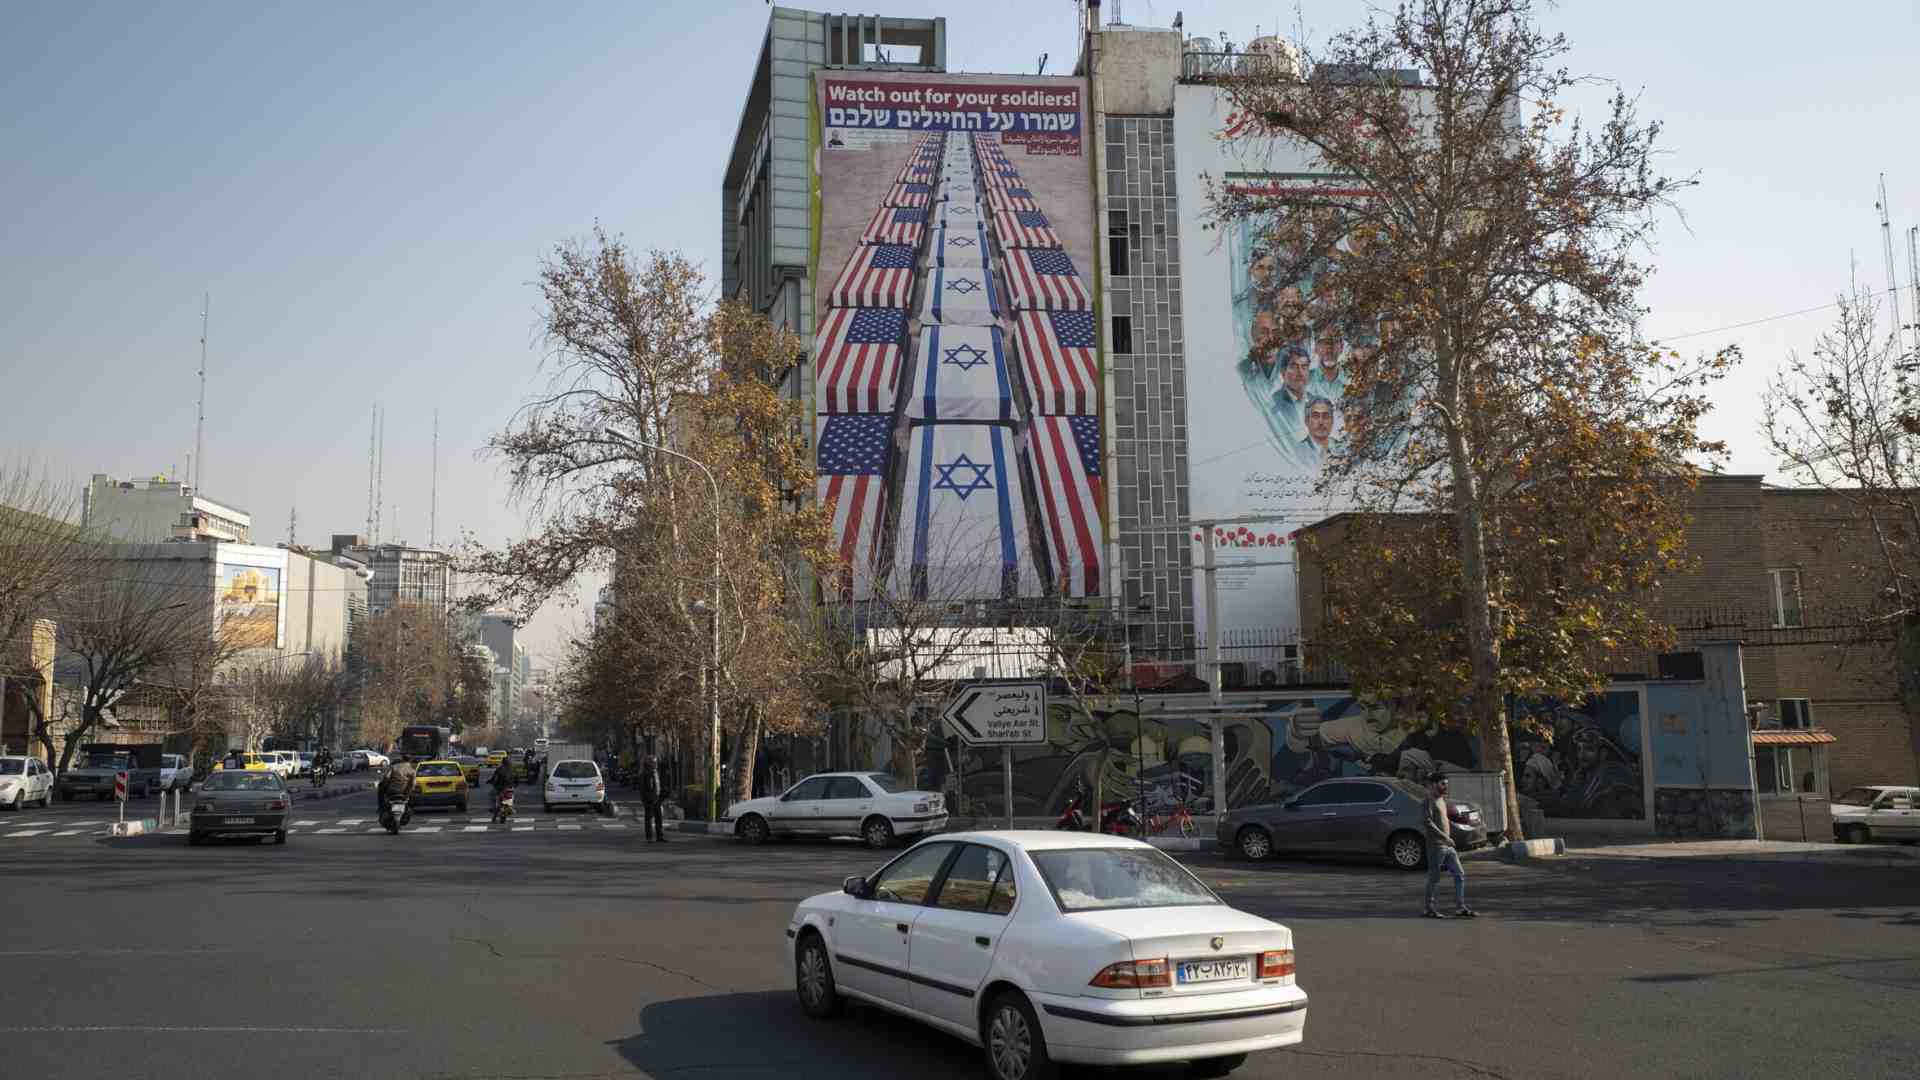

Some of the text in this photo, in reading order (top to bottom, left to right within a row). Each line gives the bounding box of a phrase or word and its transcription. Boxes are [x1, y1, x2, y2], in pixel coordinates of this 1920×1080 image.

[828, 85, 1077, 108] Watch out for your soldiers!
[829, 102, 1076, 131] שמרו על החיילים שלכם
